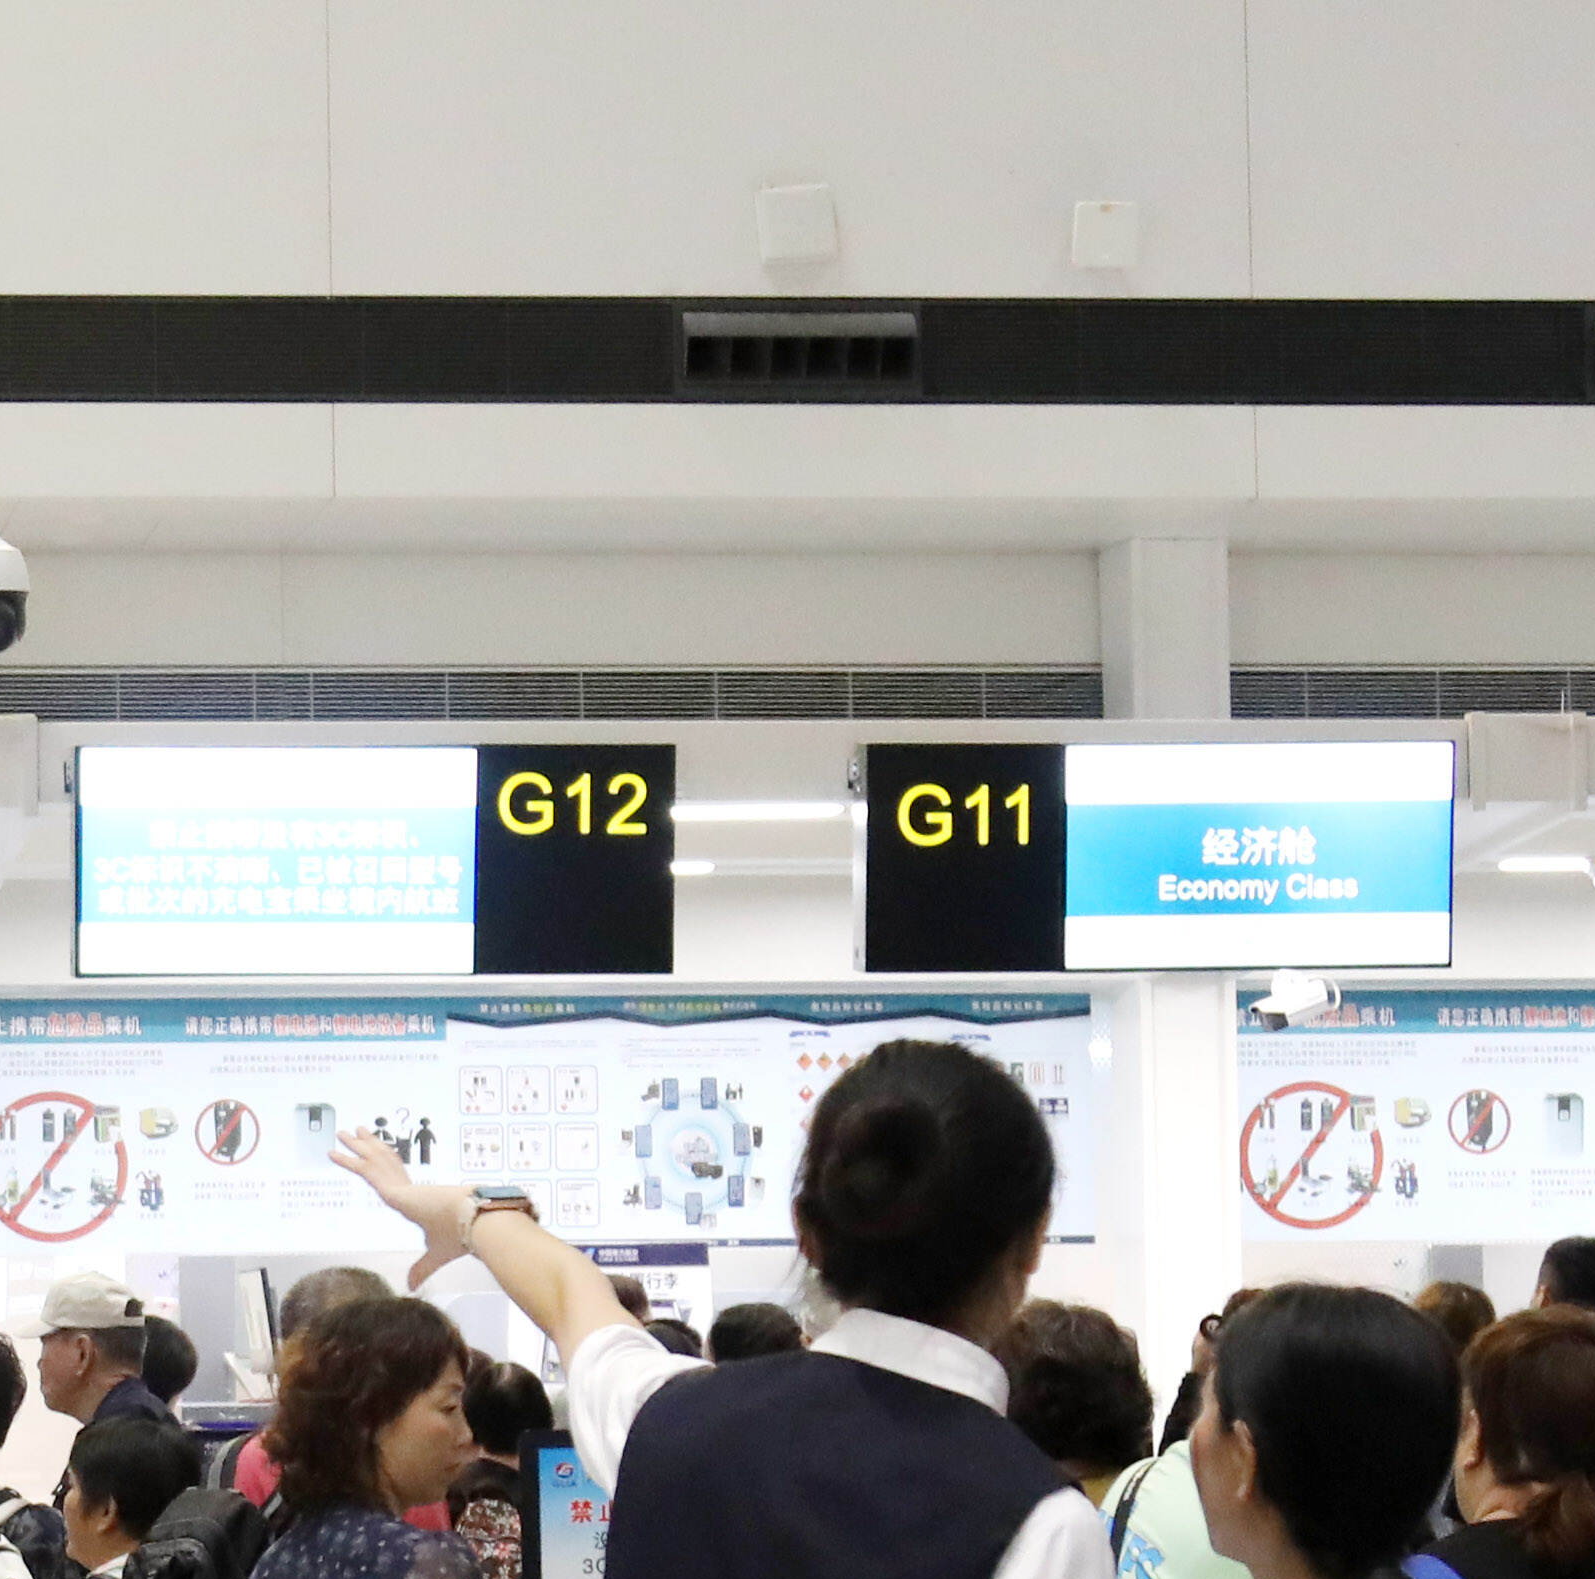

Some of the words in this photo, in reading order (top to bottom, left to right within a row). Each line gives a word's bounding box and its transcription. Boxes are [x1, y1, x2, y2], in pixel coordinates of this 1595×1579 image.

[498, 772, 647, 835] G12
[898, 784, 1029, 846] G11
[1202, 827, 1316, 866] 经济舱
[1158, 876, 1278, 904] Economy
[1287, 875, 1358, 900] Class
